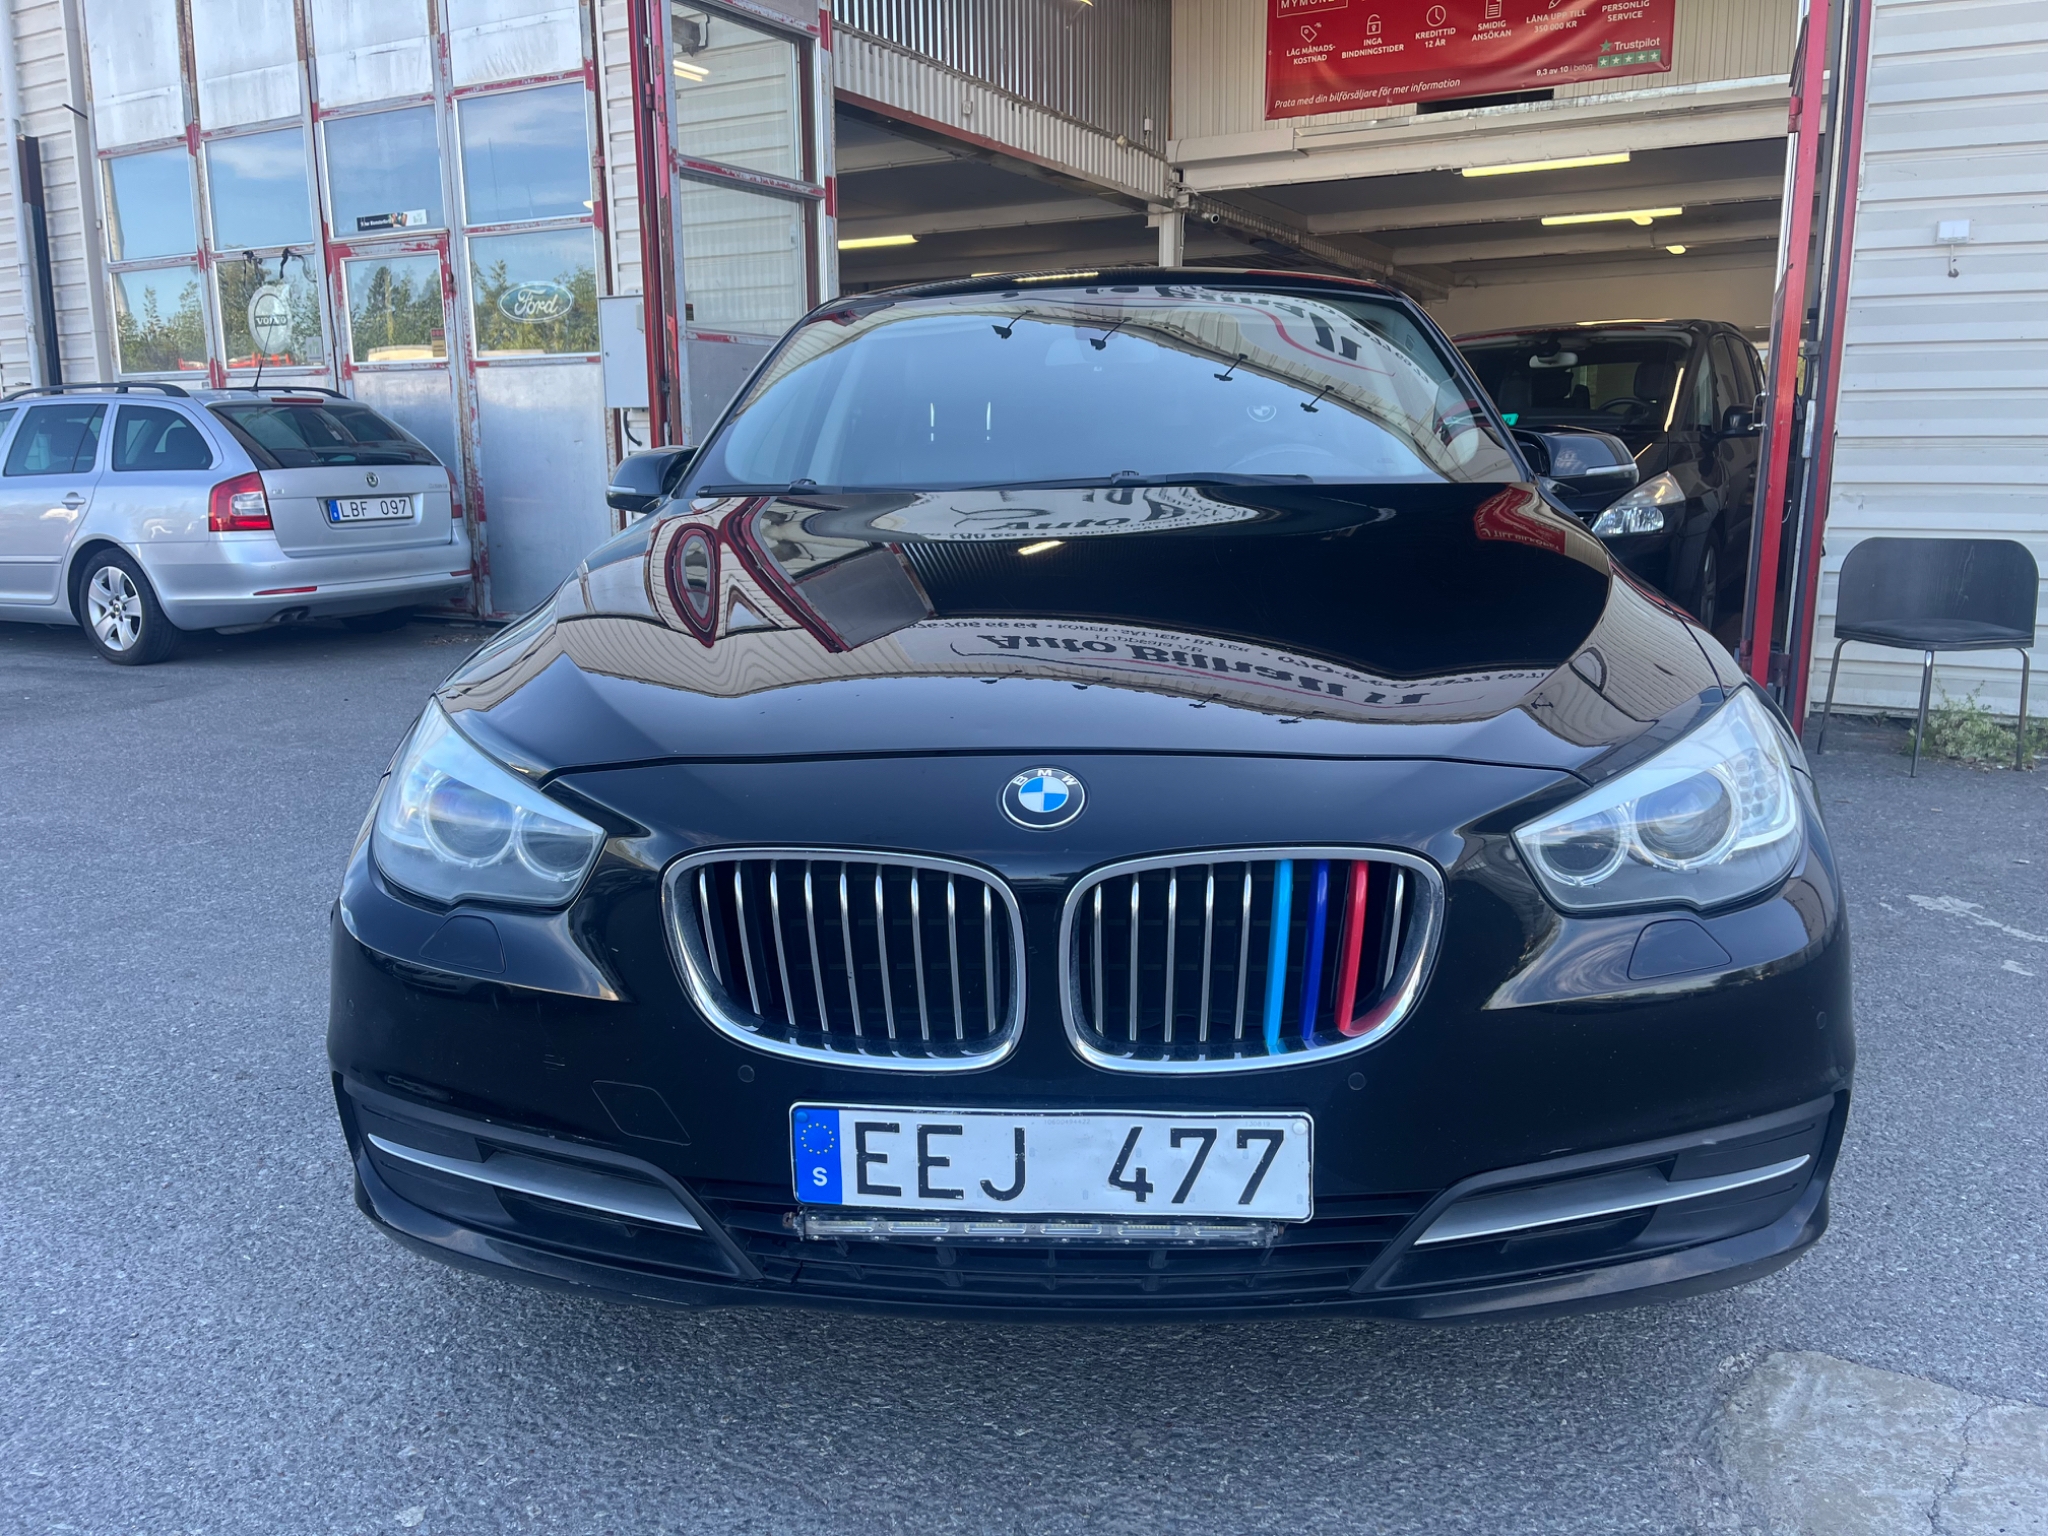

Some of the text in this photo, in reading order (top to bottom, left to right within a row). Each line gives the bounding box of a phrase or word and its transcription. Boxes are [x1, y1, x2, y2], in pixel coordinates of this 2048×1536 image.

[1601, 0, 1650, 13] PERSONLIG
[1526, 9, 1587, 24] LÅNA UPP TILL
[1607, 10, 1643, 22] SERVICE
[1477, 20, 1507, 31] SMIDIG
[1534, 20, 1578, 33] 350 000 KR
[1415, 27, 1456, 40] KREDITTID
[1471, 30, 1512, 42] ANSÖKAN
[1363, 38, 1382, 46] INGA
[1434, 39, 1446, 47] ÅR
[1614, 37, 1660, 51] Trustpilot
[1286, 44, 1336, 57] LÅG MÅNADS-
[1341, 44, 1405, 59] BINDNINGSTIDER
[1293, 54, 1328, 65] KOSTNAD
[1536, 68, 1548, 77] 9,3
[1560, 65, 1569, 73] 10
[1274, 78, 1461, 109] Prata med din bilförsäljare för mer information
[514, 288, 558, 316] Ford
[339, 501, 368, 518] LBF
[380, 499, 407, 516] 097
[1012, 769, 1078, 786] BMW
[855, 1120, 1285, 1205] EEJ 477
[812, 1166, 828, 1187] S
